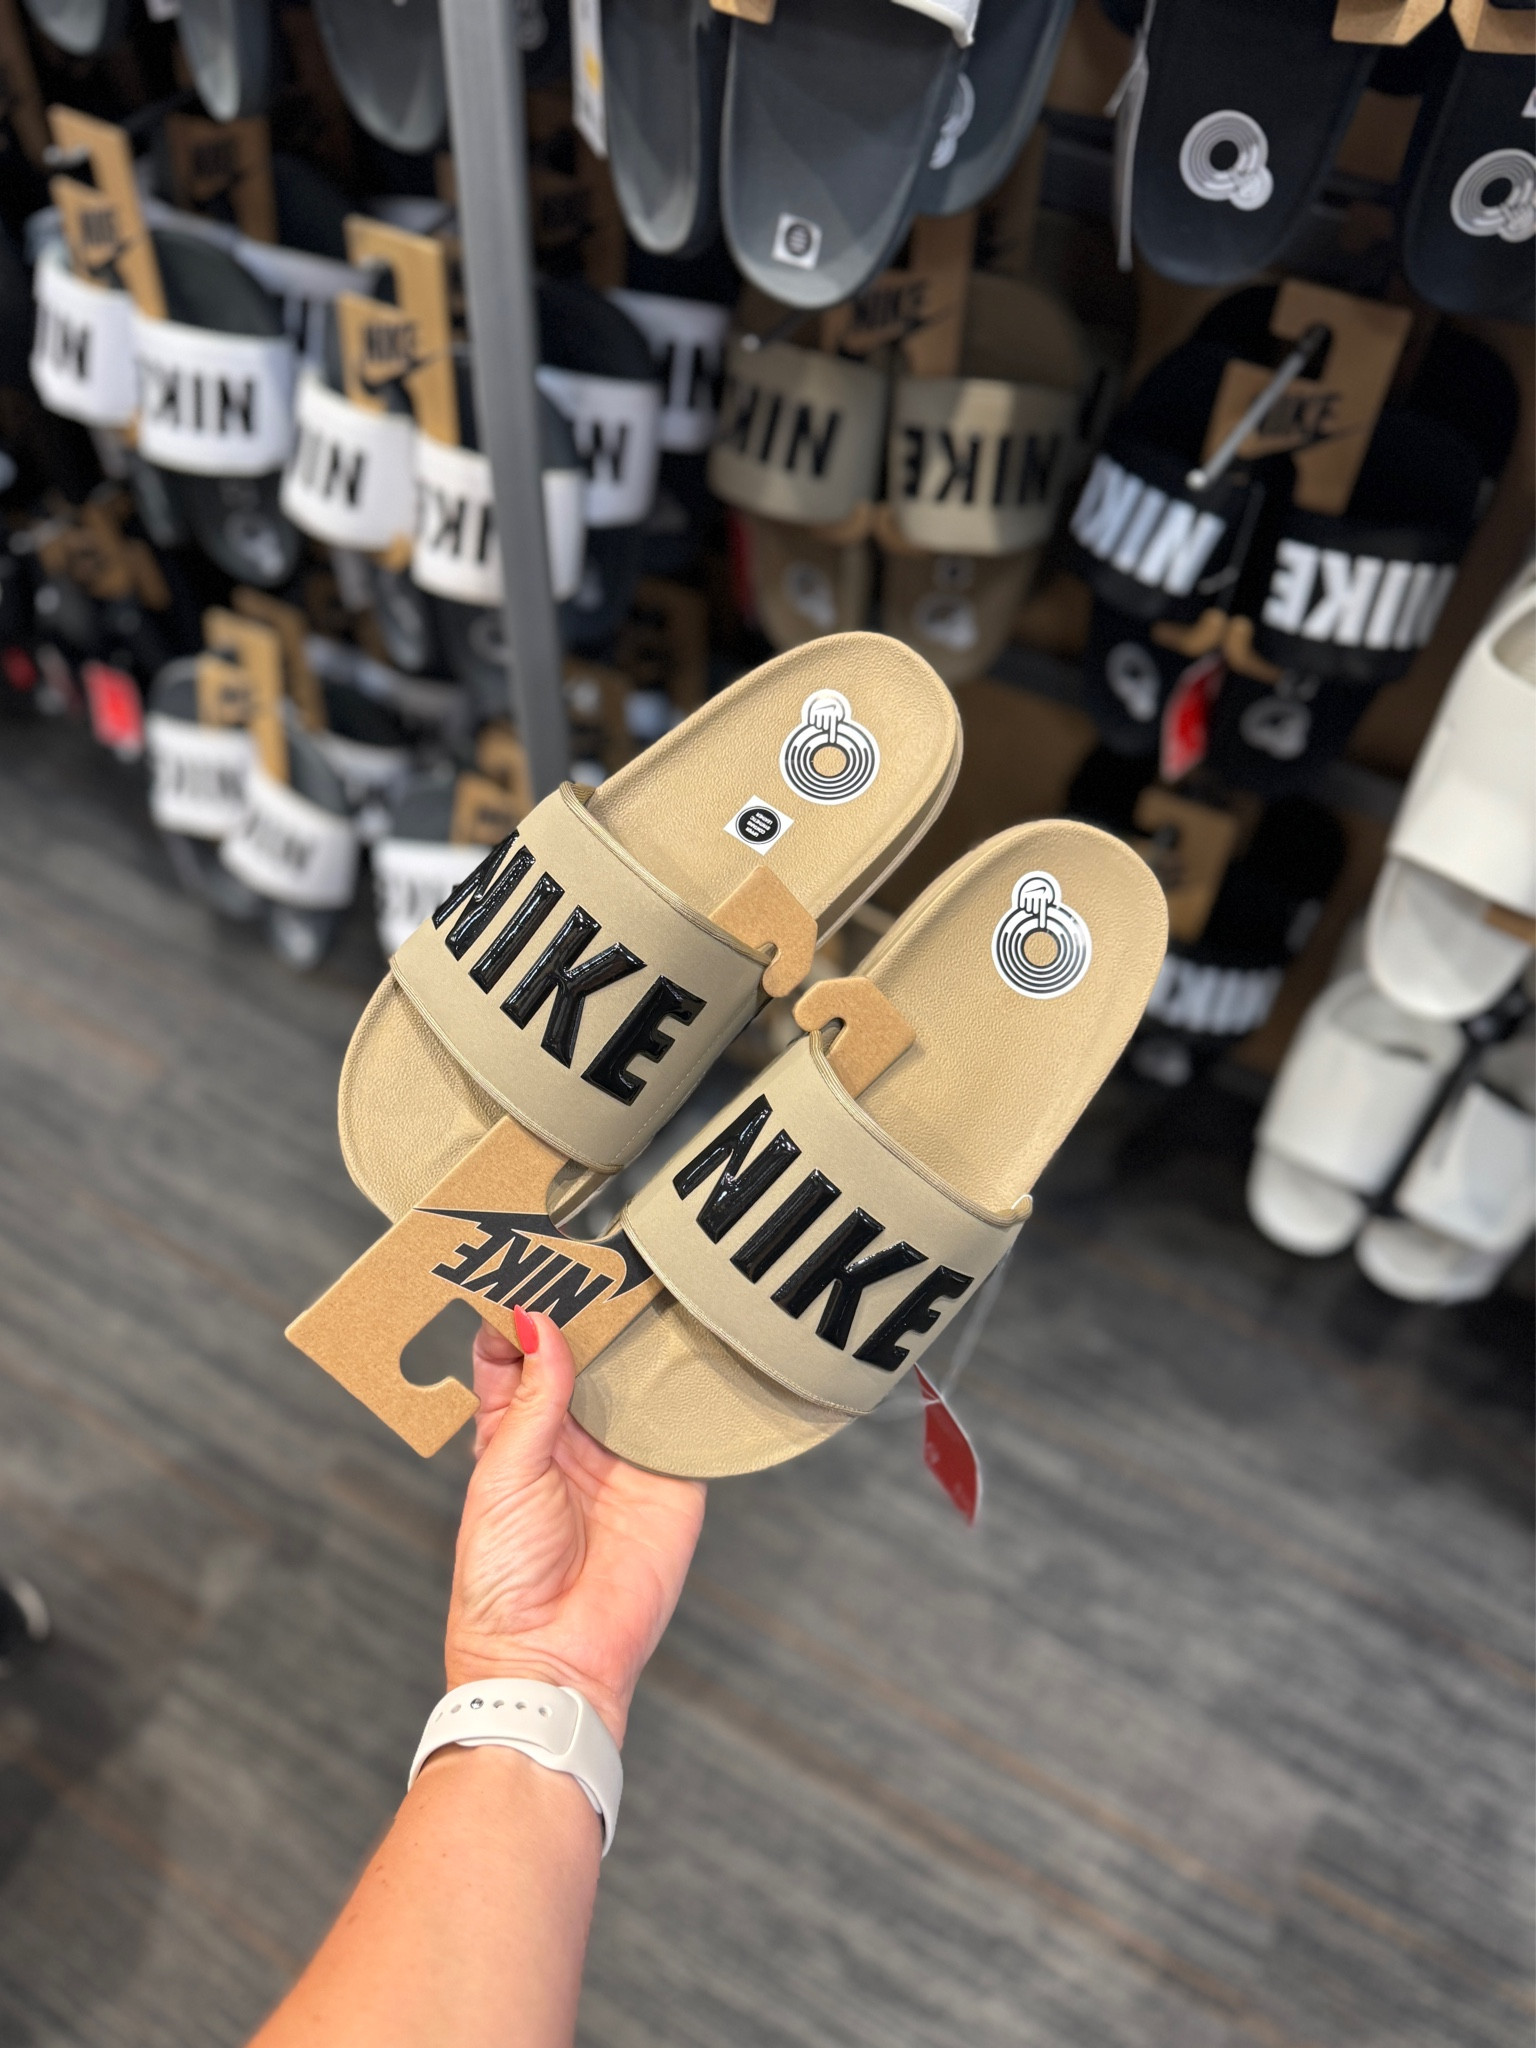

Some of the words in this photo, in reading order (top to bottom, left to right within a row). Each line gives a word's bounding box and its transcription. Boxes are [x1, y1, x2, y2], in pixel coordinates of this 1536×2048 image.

[431, 829, 707, 1106] NIKE
[429, 1221, 616, 1331] NIKE
[672, 1093, 976, 1373] NIKE
